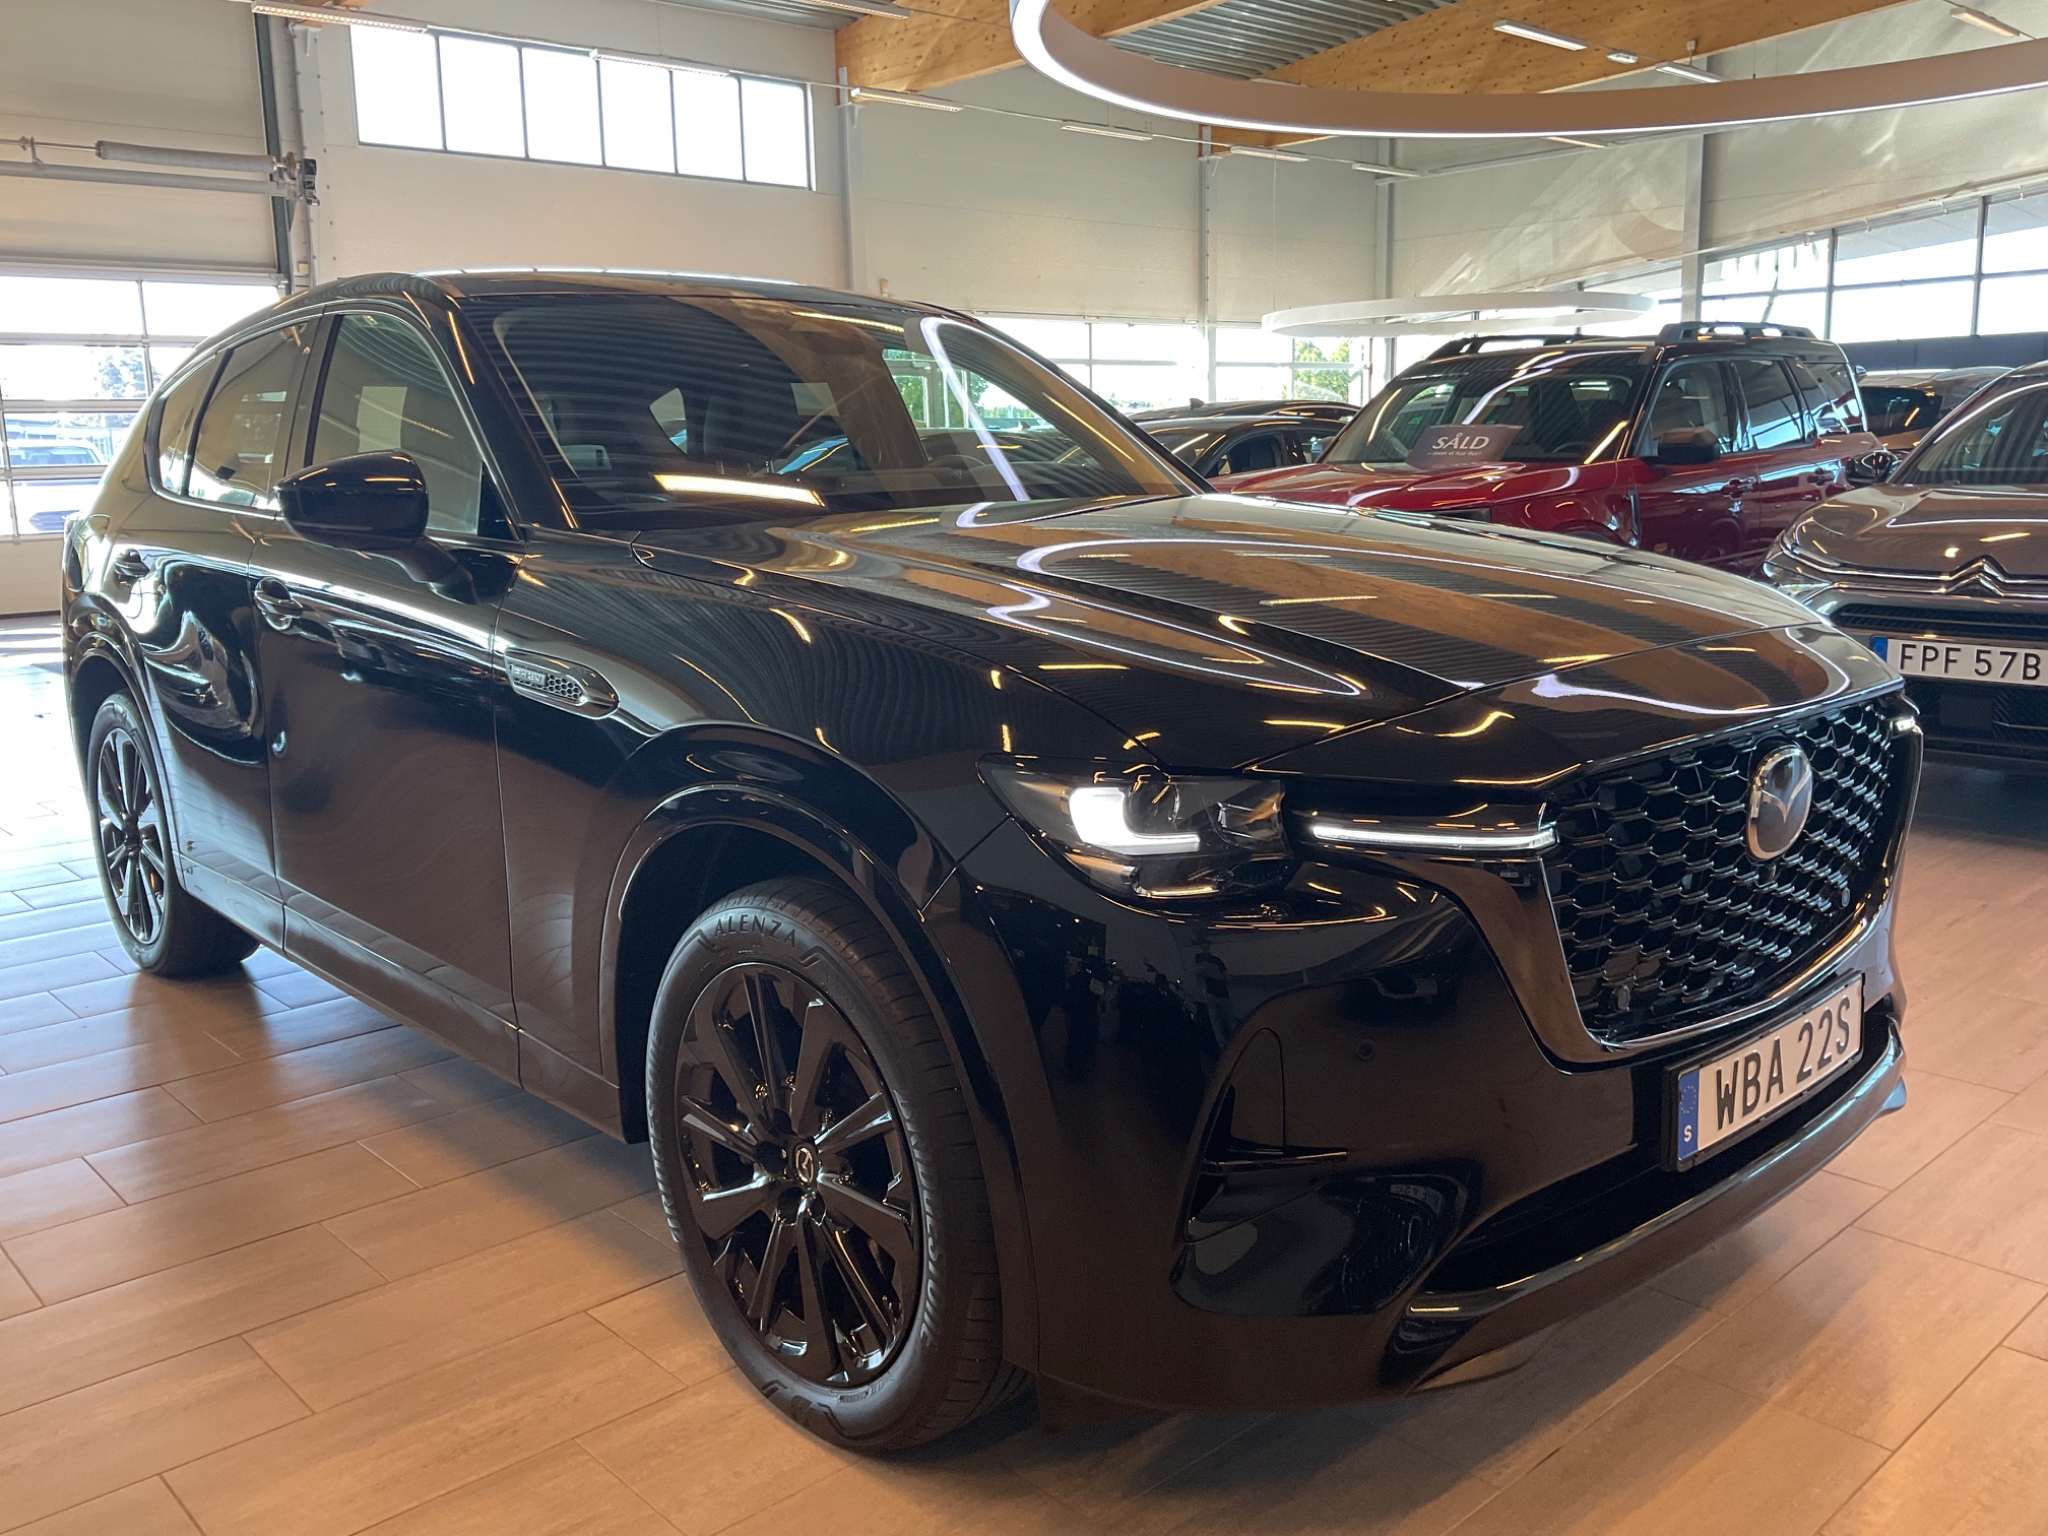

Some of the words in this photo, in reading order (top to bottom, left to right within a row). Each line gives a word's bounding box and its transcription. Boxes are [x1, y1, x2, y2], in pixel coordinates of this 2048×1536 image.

[1432, 432, 1490, 450] SÅLD
[1899, 643, 1962, 674] FPF
[1974, 649, 2041, 681] 57B
[714, 913, 798, 949] ALENZA
[1715, 1036, 1784, 1131] WBA
[1796, 994, 1851, 1084] 22S
[1683, 1125, 1692, 1143] S
